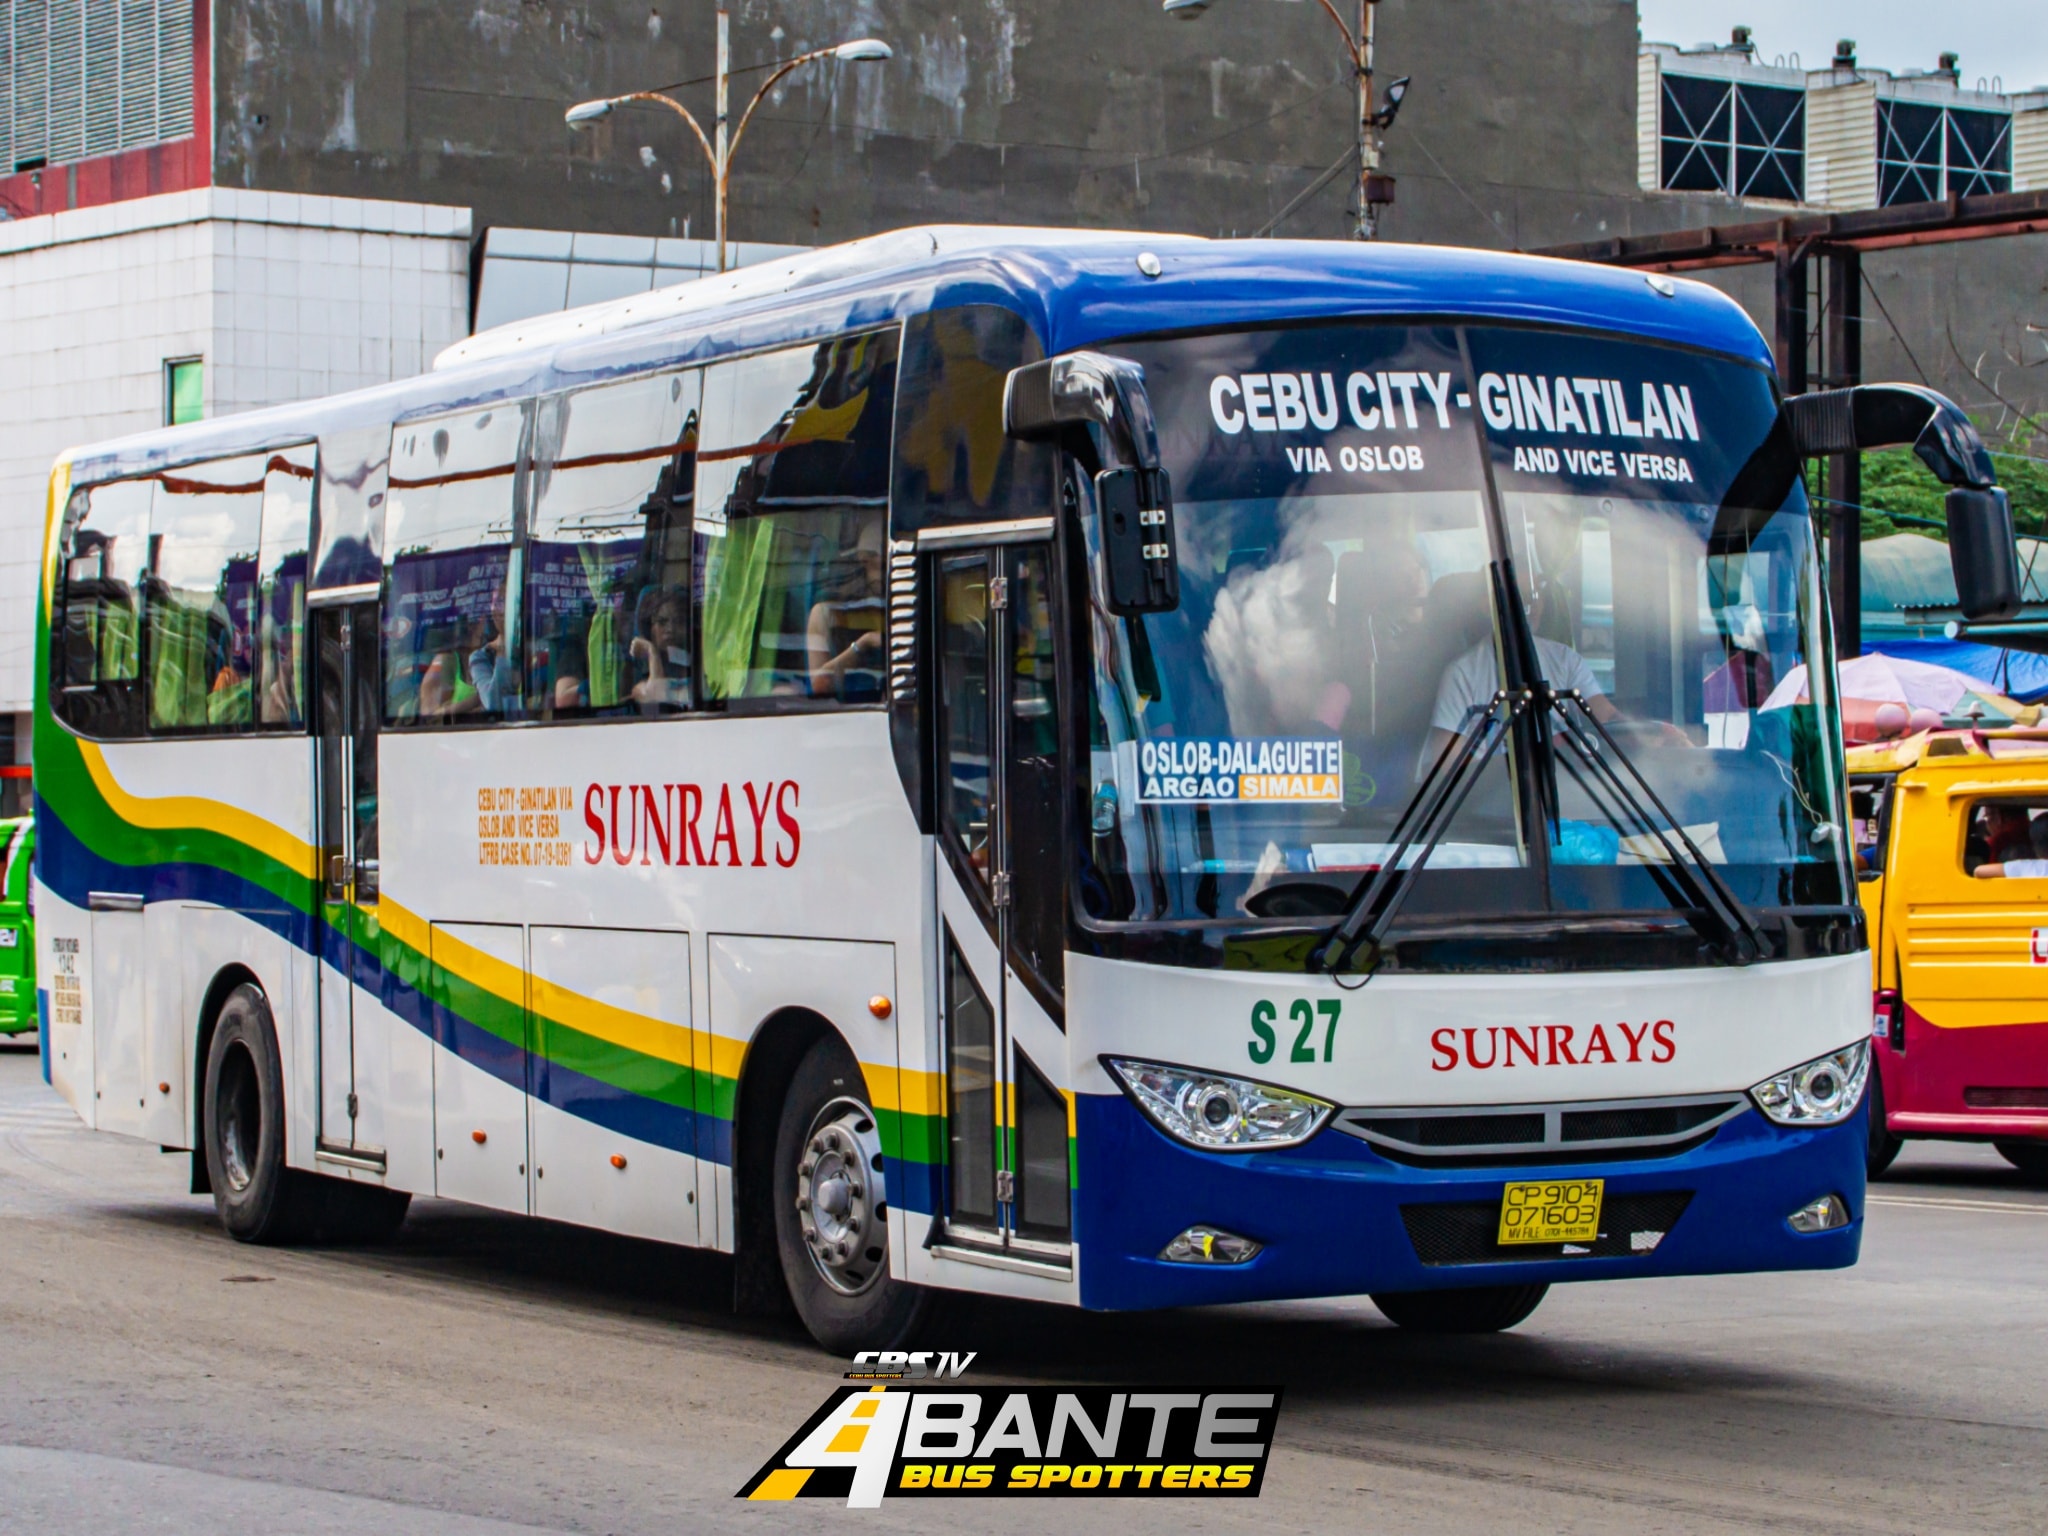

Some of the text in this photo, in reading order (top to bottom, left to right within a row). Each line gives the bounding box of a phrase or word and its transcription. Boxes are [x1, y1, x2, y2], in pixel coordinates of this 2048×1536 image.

[1209, 373, 1339, 434] CEBU
[1286, 445, 1424, 473] VIA OSLOB
[1514, 447, 1694, 483] AND VICE VERSA
[478, 787, 496, 811] CEBU
[559, 786, 573, 810] VIA
[1143, 777, 1338, 797] ARGAO SIMALA
[478, 814, 560, 838] OSLOB AND VICE VERSA
[584, 780, 801, 867] SUNRAYS
[501, 842, 519, 865] CASE
[1248, 999, 1342, 1064] S 27
[1430, 1020, 1676, 1071] SUNRAYS
[1505, 1205, 1597, 1227] 071603
[1508, 1228, 1521, 1239] MV
[1522, 1227, 1540, 1239] FILE
